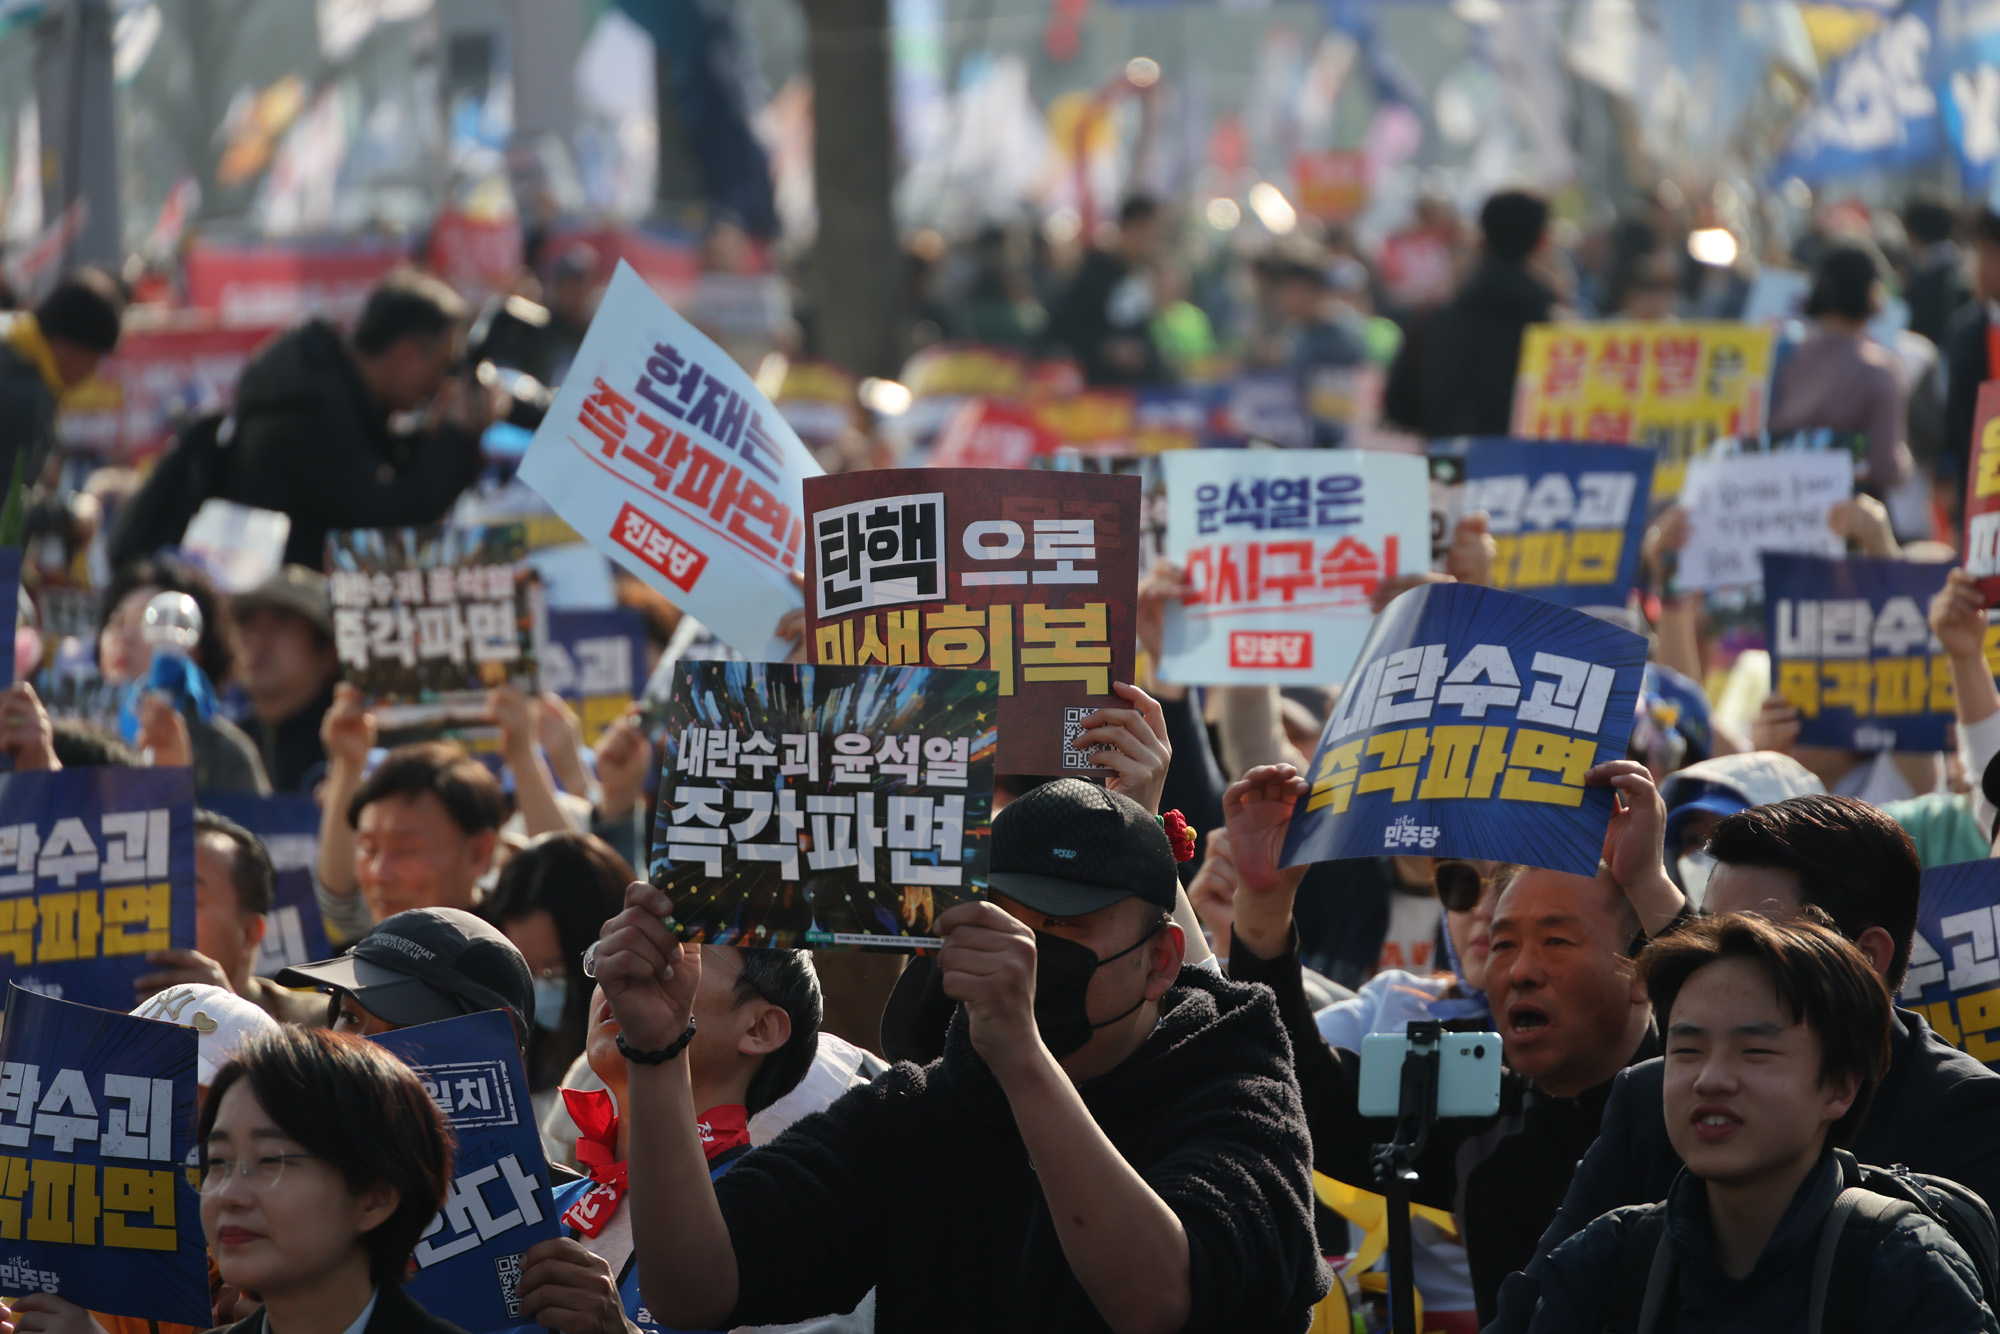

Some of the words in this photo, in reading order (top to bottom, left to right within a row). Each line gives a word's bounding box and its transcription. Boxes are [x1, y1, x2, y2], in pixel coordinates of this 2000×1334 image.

[635, 341, 785, 484] 헌재는
[577, 377, 804, 567] 즉각파면!
[1195, 475, 1364, 534] 윤석열은
[623, 511, 698, 579] 진보당
[820, 502, 938, 610] 탄핵
[961, 519, 1098, 586] 으로
[333, 602, 520, 671] 즉각파면
[1234, 634, 1305, 664] 진보당
[1776, 596, 1944, 657] 내란수
[1326, 643, 1615, 746] 내란수괴
[676, 727, 819, 782] 내란수괴
[831, 732, 969, 787] 윤석열
[1306, 725, 1597, 815] 즉각파면
[666, 786, 966, 886] 즉각파면
[1053, 848, 1077, 857] SPEED
[1384, 825, 1441, 848] 민주당
[0, 1264, 60, 1294] 민주당
